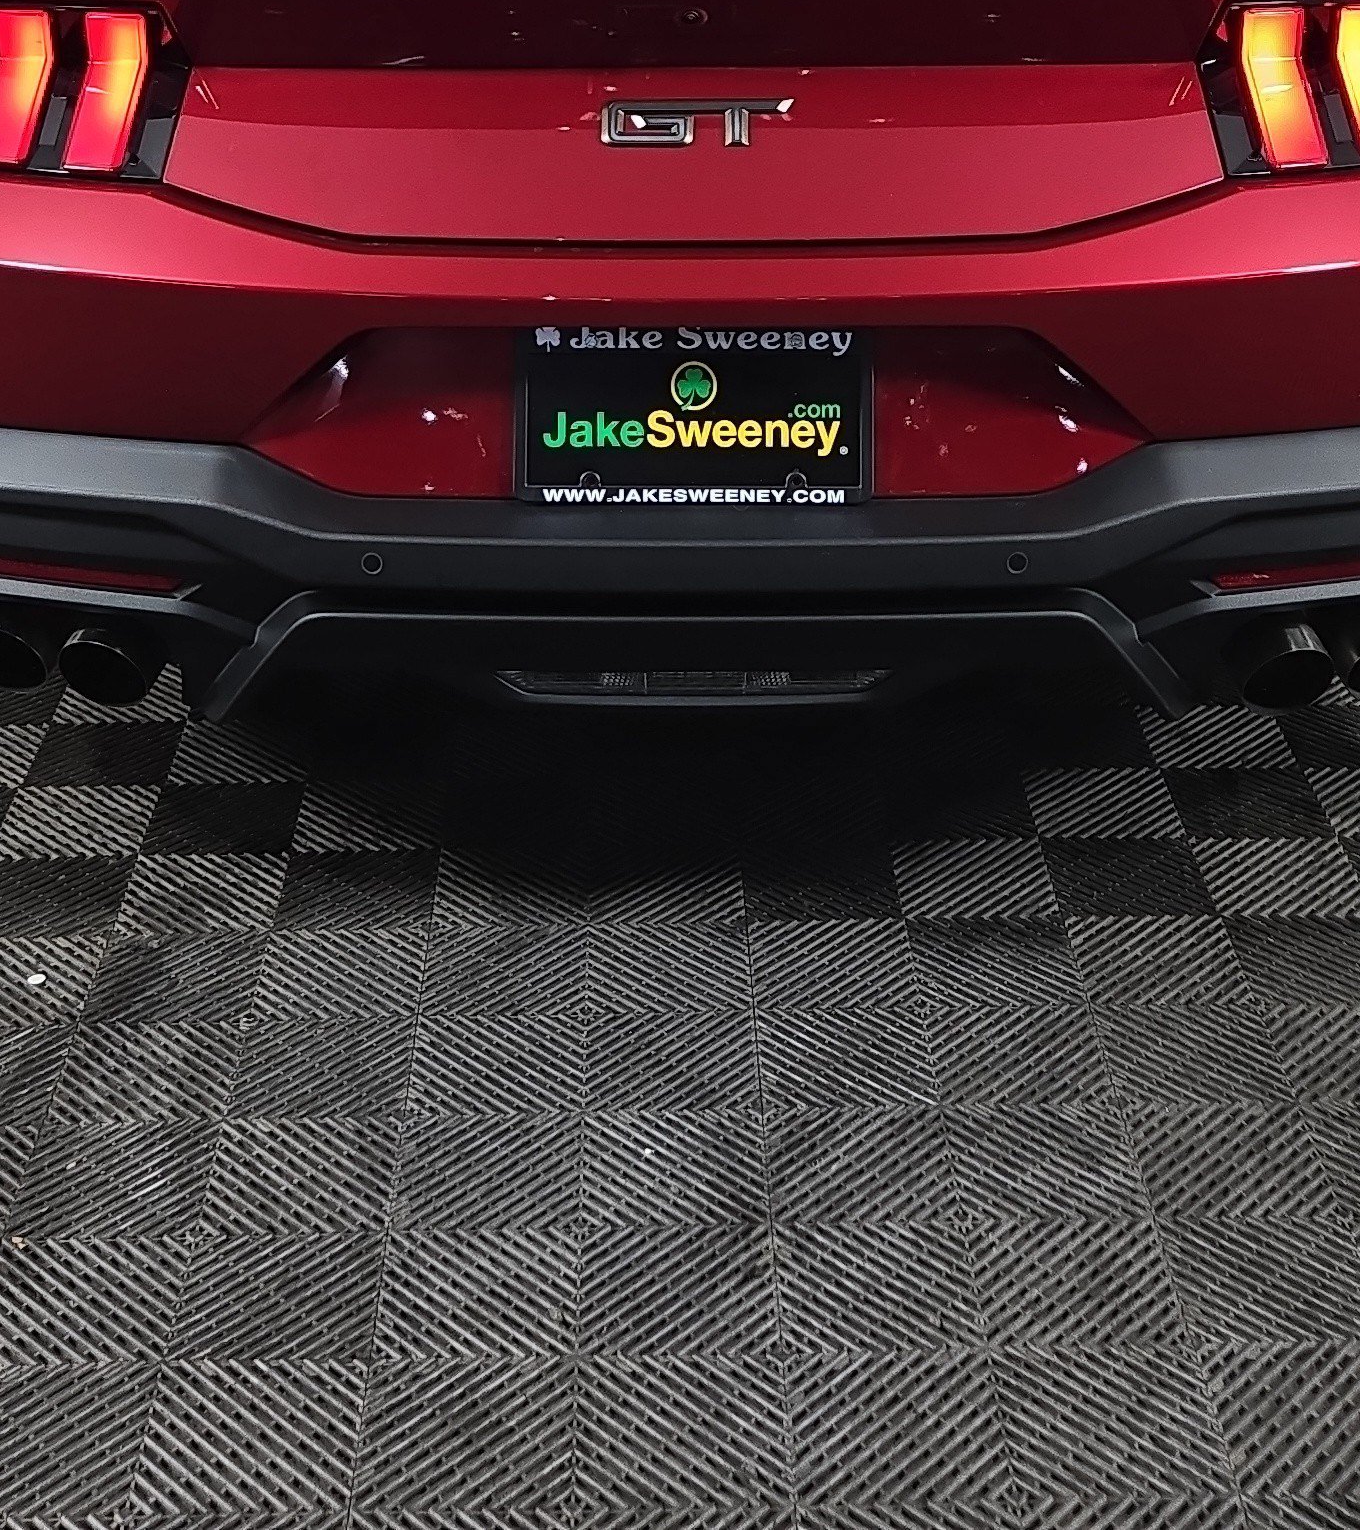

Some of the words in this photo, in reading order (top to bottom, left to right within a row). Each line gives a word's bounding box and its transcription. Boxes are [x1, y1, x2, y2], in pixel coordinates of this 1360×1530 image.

[601, 98, 796, 147] GT
[569, 327, 663, 349] Jake
[677, 327, 853, 356] Sweeney
[542, 488, 846, 504] WWW.JAKESWEENEY.COM
